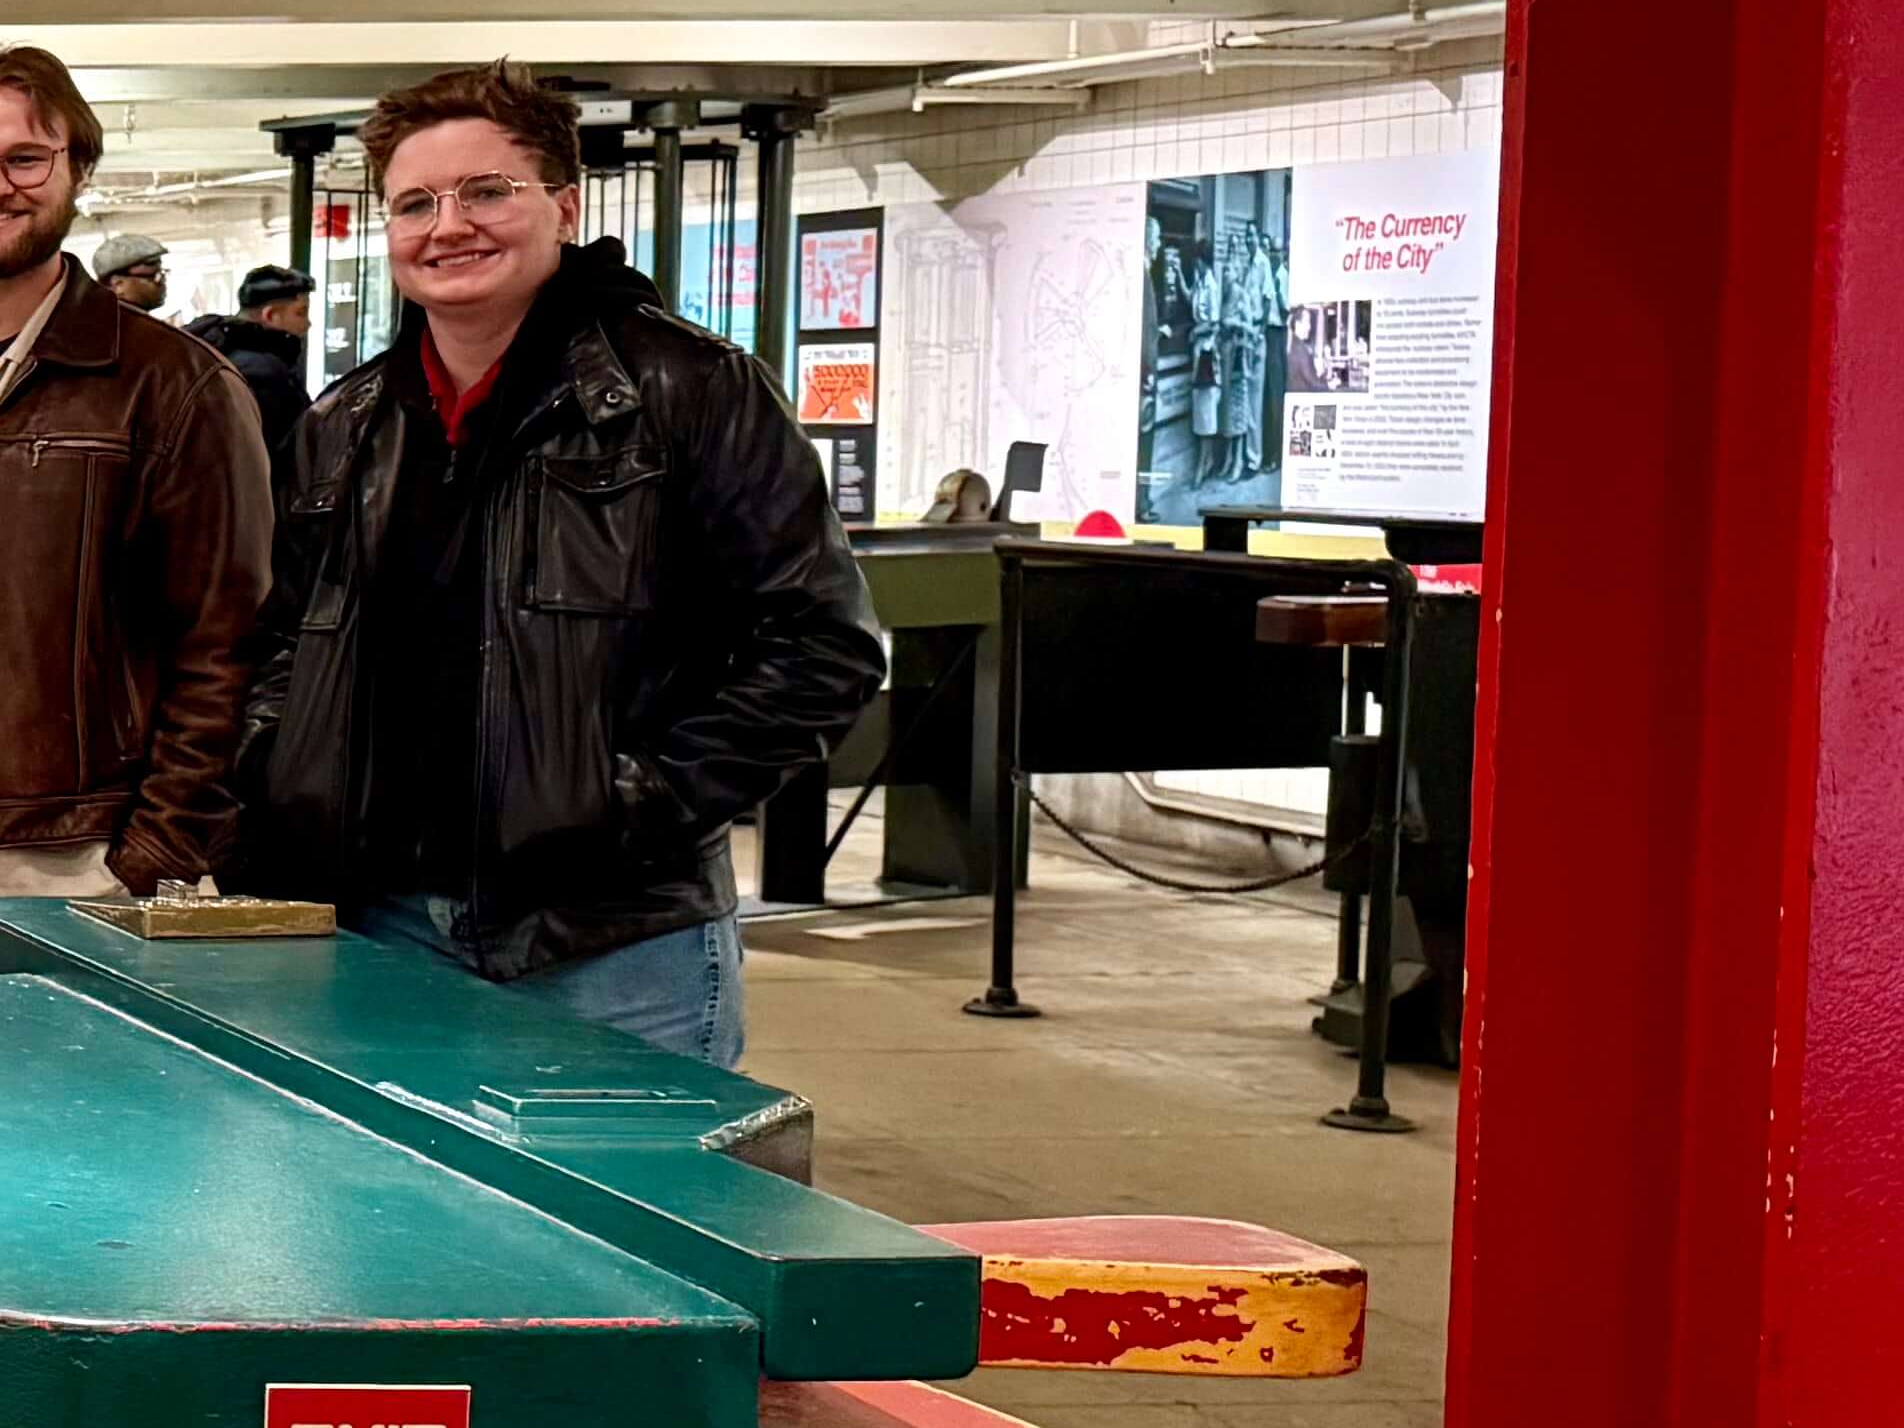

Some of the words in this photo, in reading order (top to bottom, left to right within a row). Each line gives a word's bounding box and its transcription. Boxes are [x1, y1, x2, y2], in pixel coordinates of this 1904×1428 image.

[1381, 213, 1467, 240] Currency
[1343, 247, 1362, 271] of
[1365, 246, 1392, 270] the
